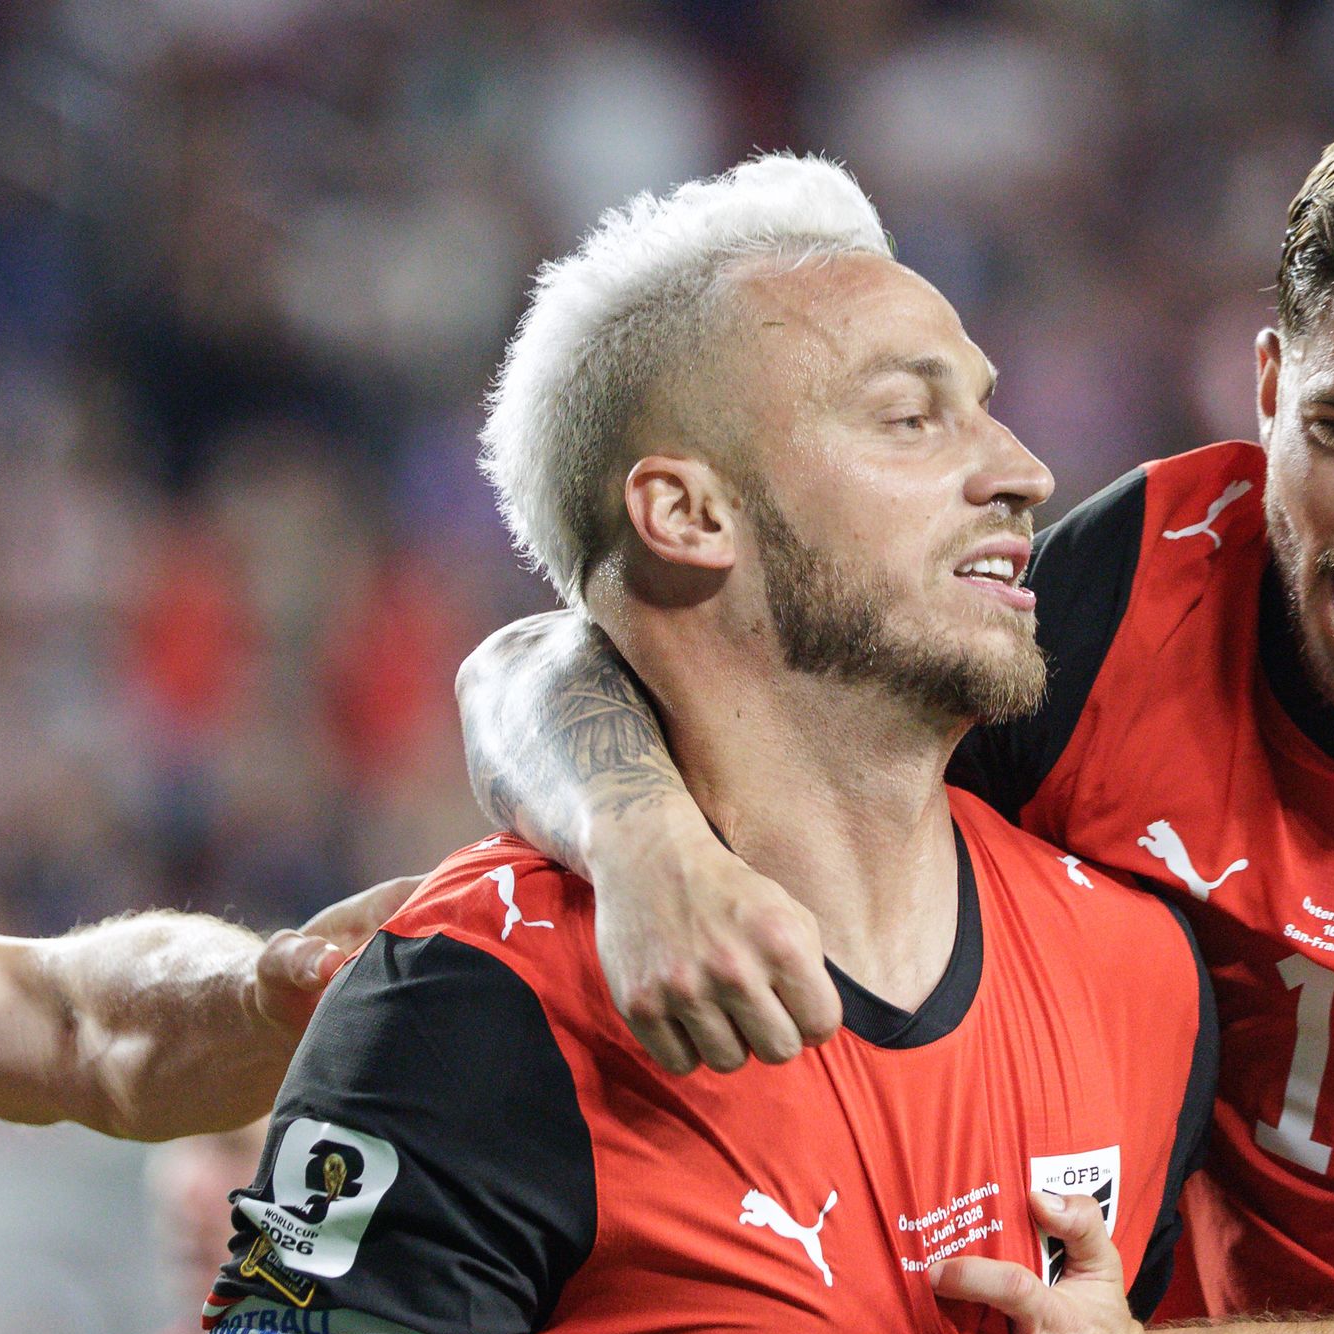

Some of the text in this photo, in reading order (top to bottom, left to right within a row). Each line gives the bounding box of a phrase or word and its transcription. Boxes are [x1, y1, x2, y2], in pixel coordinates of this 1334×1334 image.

[1063, 1166, 1099, 1186] ÖFB
[951, 1182, 999, 1212] Jordanie
[260, 1220, 315, 1255] 2026
[264, 1207, 294, 1231] WORLD
[295, 1228, 319, 1239] CUP
[931, 1219, 956, 1243] Juni
[955, 1205, 983, 1229] 2026
